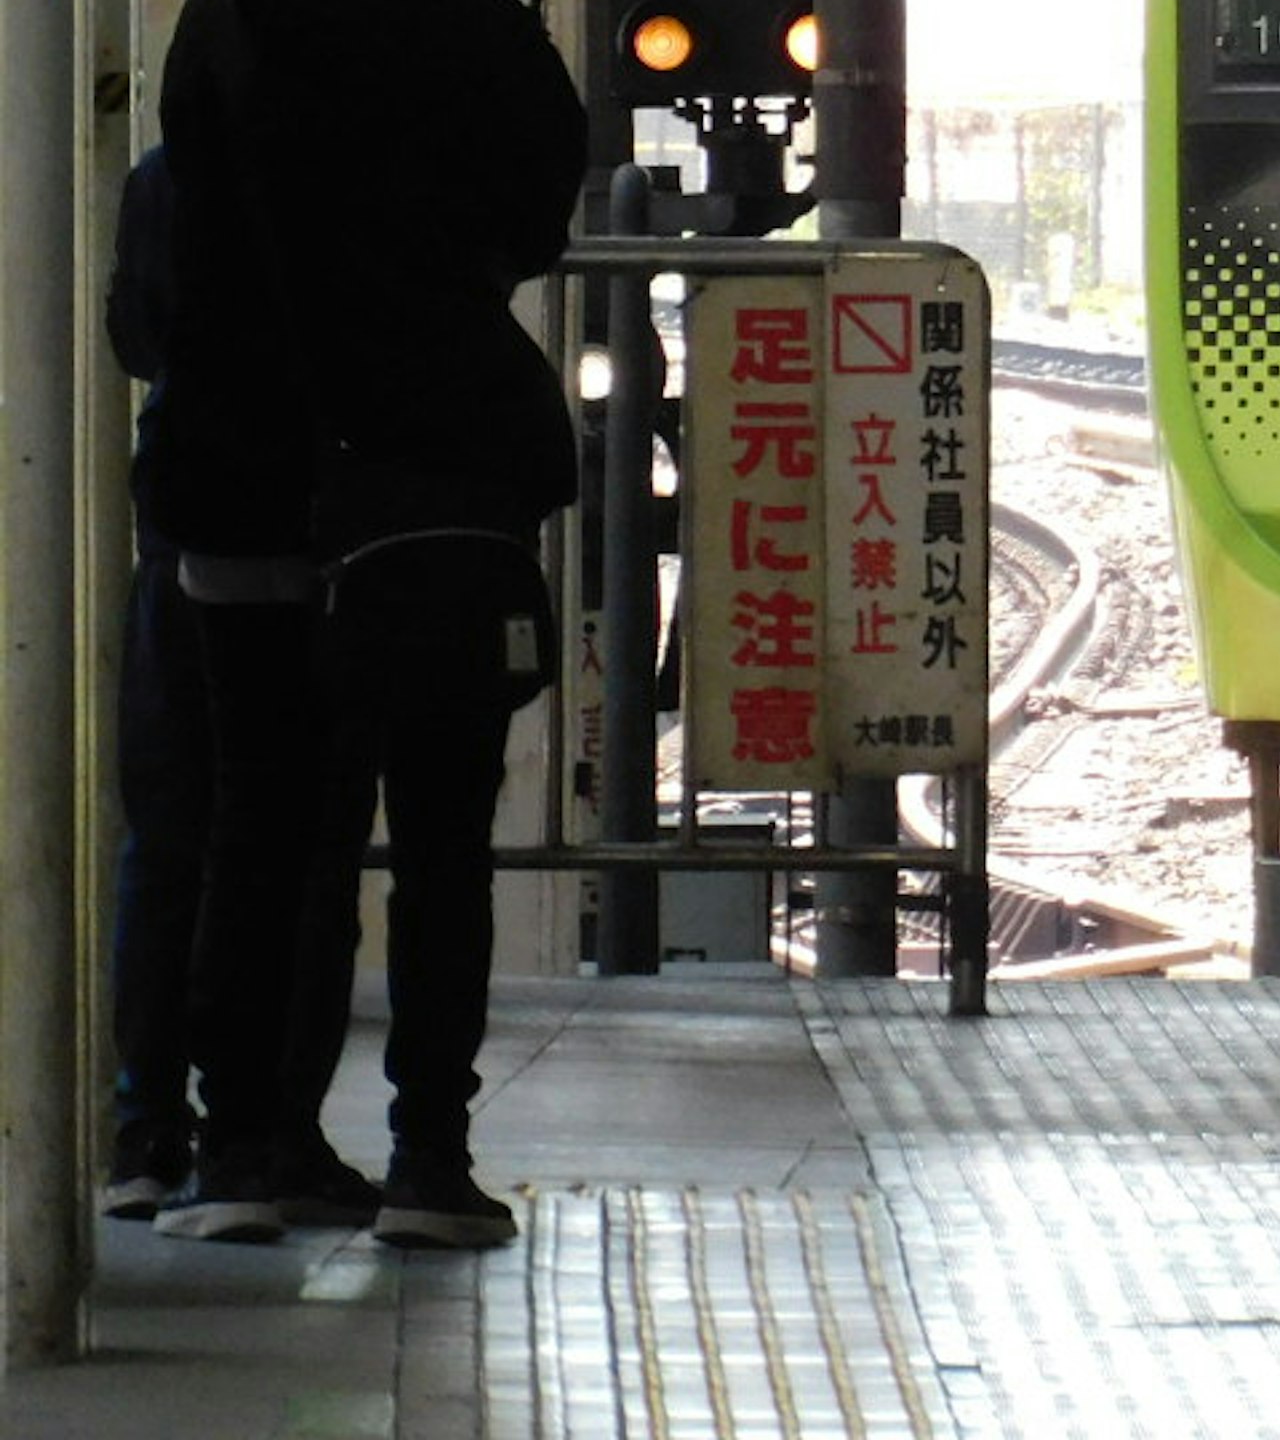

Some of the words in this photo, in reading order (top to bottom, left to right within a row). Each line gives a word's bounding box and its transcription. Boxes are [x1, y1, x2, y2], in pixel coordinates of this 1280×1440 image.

[731, 308, 815, 762] 足元に注意
[851, 413, 897, 653] 立入禁止
[920, 302, 966, 668] 関係社員以外
[854, 715, 954, 748] 大崎駅長
